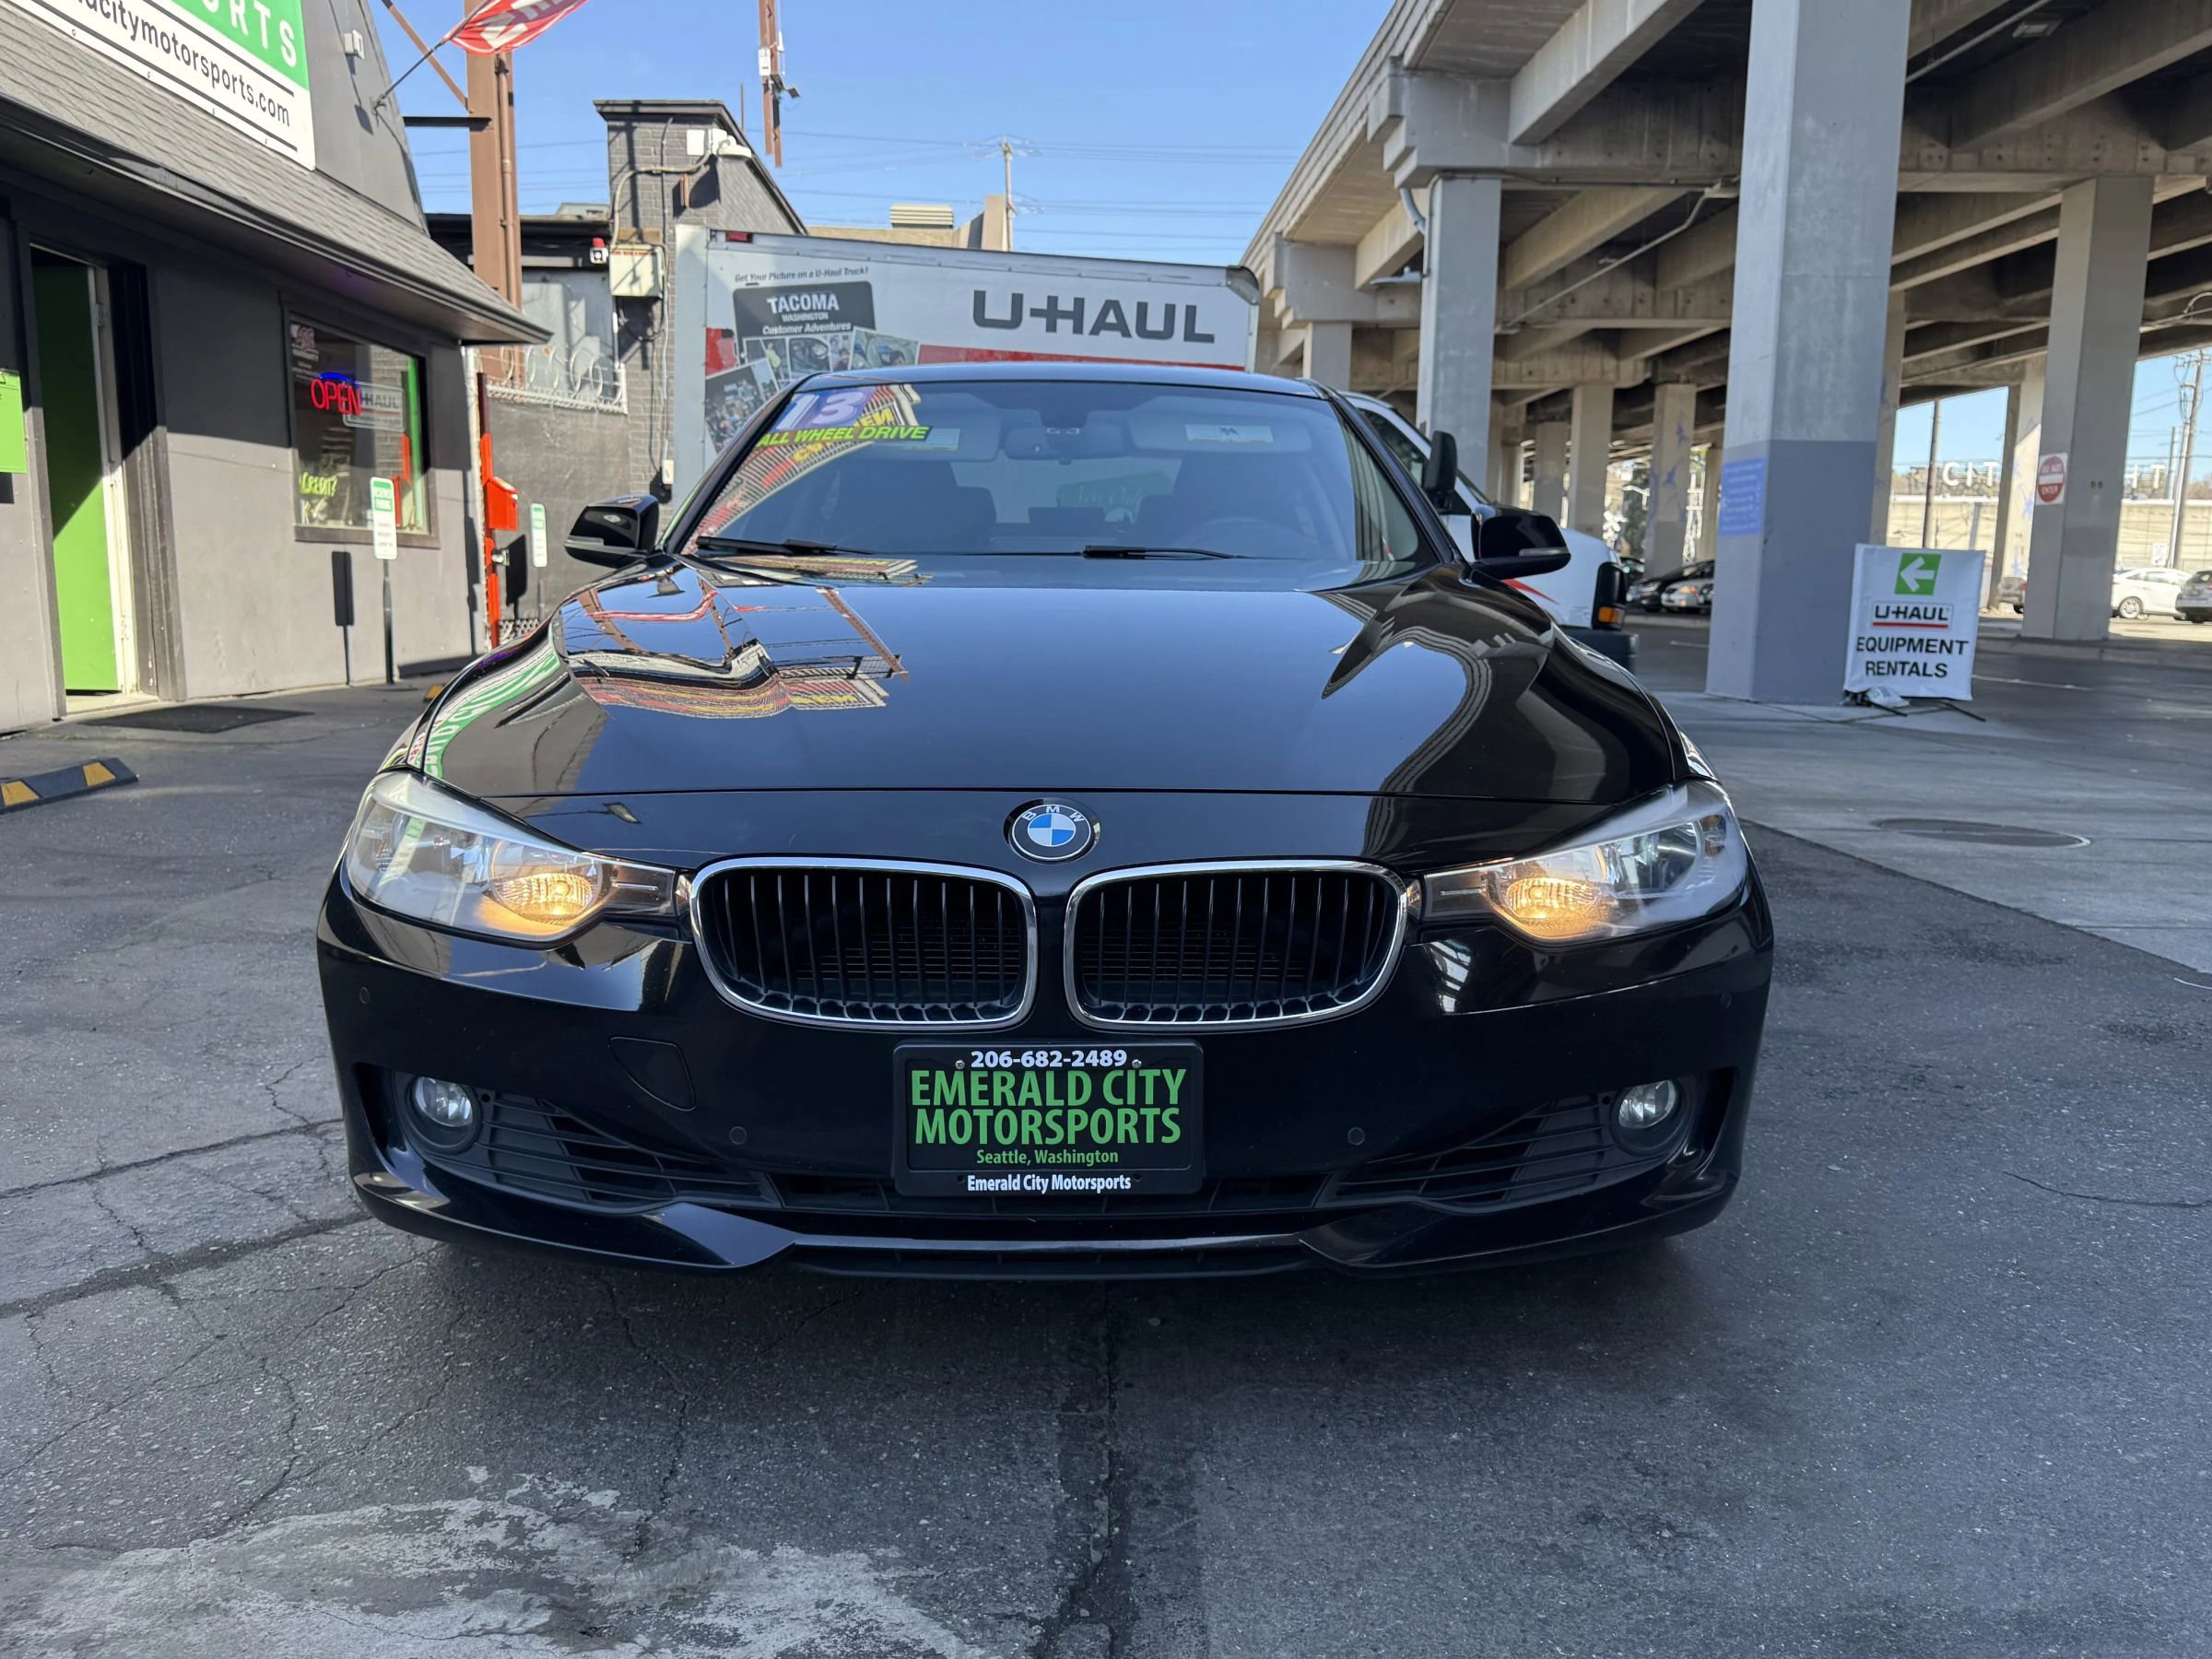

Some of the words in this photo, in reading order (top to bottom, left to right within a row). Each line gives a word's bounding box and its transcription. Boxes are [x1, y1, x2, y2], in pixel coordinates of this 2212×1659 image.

[768, 271, 795, 280] Picture
[767, 293, 840, 313] TACOMA
[782, 312, 829, 322] WASHINGTON
[973, 289, 1215, 344] U-HAUL
[762, 325, 803, 335] Customer
[804, 323, 852, 332] Adventures
[311, 379, 362, 416] OPEN
[776, 391, 864, 430] 13
[755, 432, 790, 447] ALL
[794, 427, 854, 442] WHEEL
[858, 426, 929, 440] DRIVE
[2041, 486, 2058, 495] ENTER
[1875, 606, 1948, 620] U-HAUL
[1856, 637, 1969, 655] EQUIPMENT
[1865, 661, 1947, 677] RENTALS
[1021, 806, 1085, 823] BMW
[971, 1050, 1127, 1067] 206-682-2489
[912, 1069, 1092, 1107] EMERALD
[1102, 1069, 1187, 1105] CITY
[915, 1108, 1181, 1145] MOTORSPORTS
[976, 1149, 1031, 1165] Seattle,
[1034, 1150, 1119, 1167] Washington
[968, 1174, 1021, 1191] Emerald
[1023, 1174, 1049, 1194] City
[1051, 1173, 1131, 1193] Motorsports
